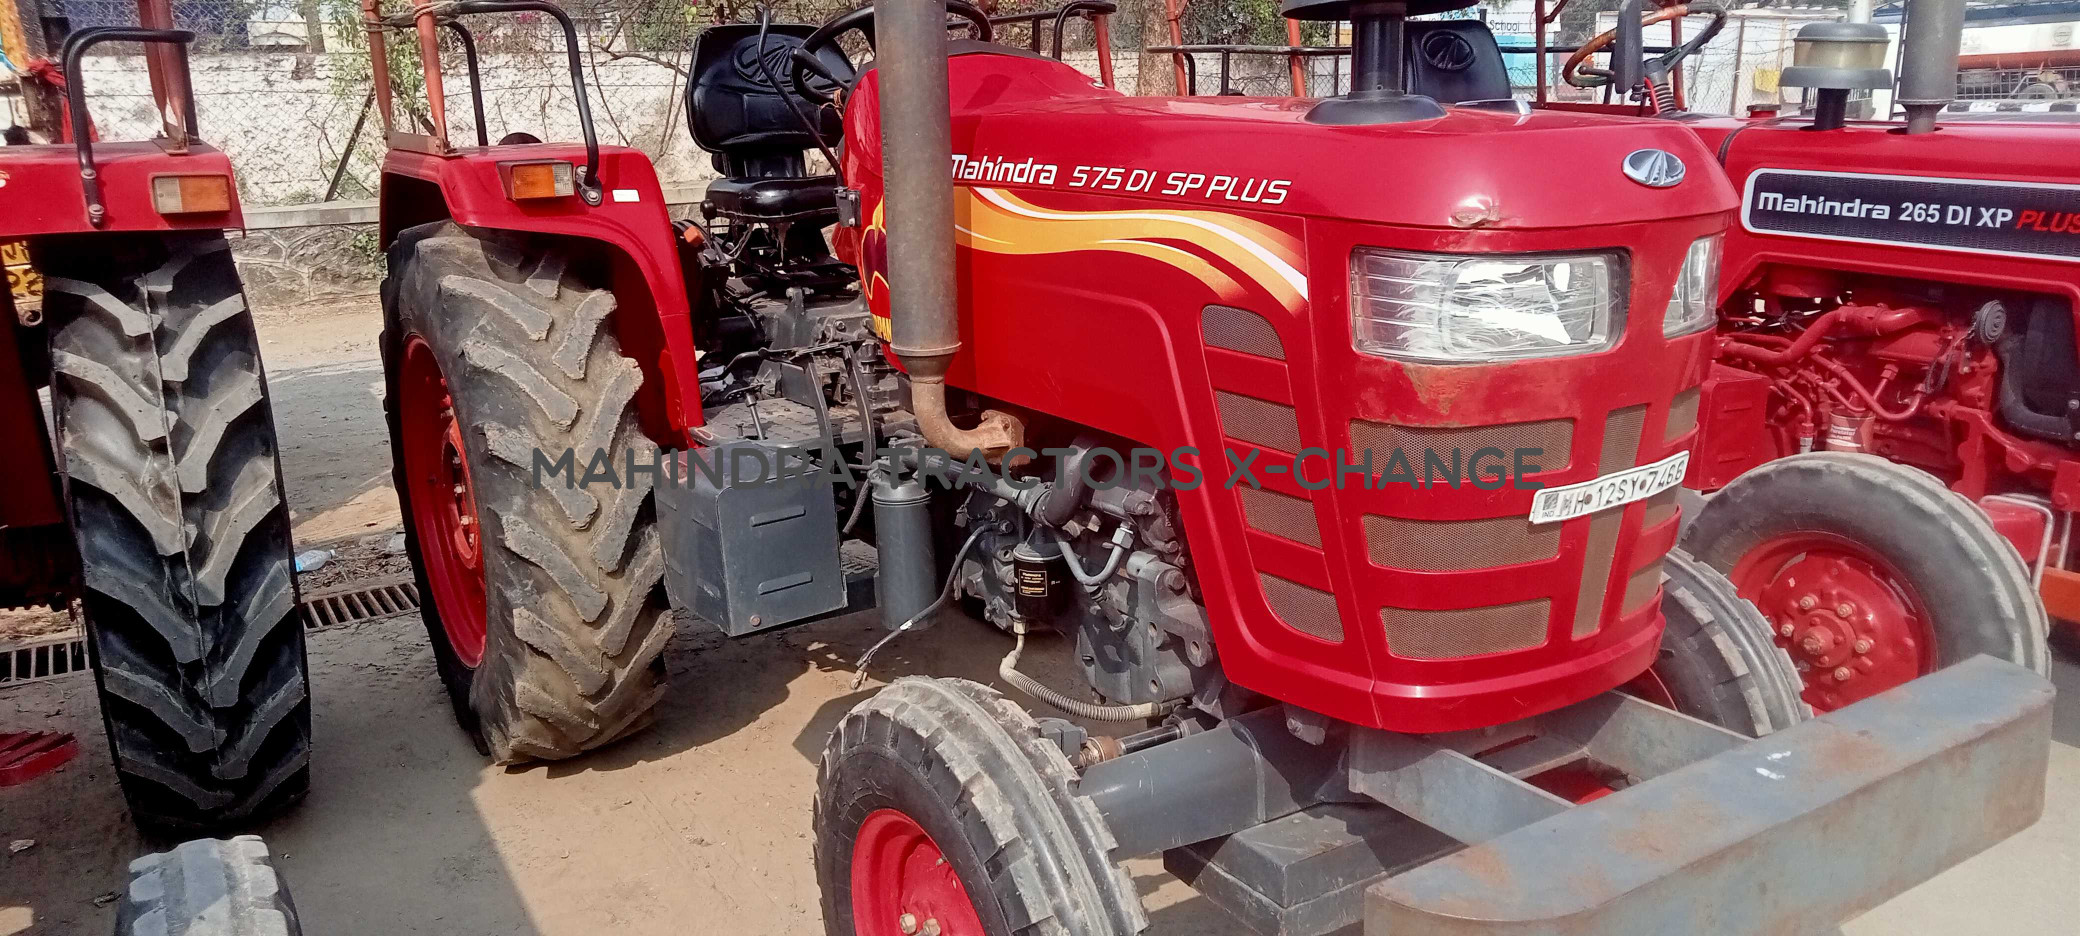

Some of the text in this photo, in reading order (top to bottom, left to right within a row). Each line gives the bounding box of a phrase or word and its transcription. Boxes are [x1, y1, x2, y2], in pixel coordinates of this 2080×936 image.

[1490, 20, 1520, 32] School
[951, 154, 1292, 205] Mahindra 575 DI SP PLUS
[1757, 191, 1892, 221] Mahindra
[1898, 201, 1941, 224] 265
[1945, 204, 1973, 226] DI
[1975, 206, 2014, 229] XP
